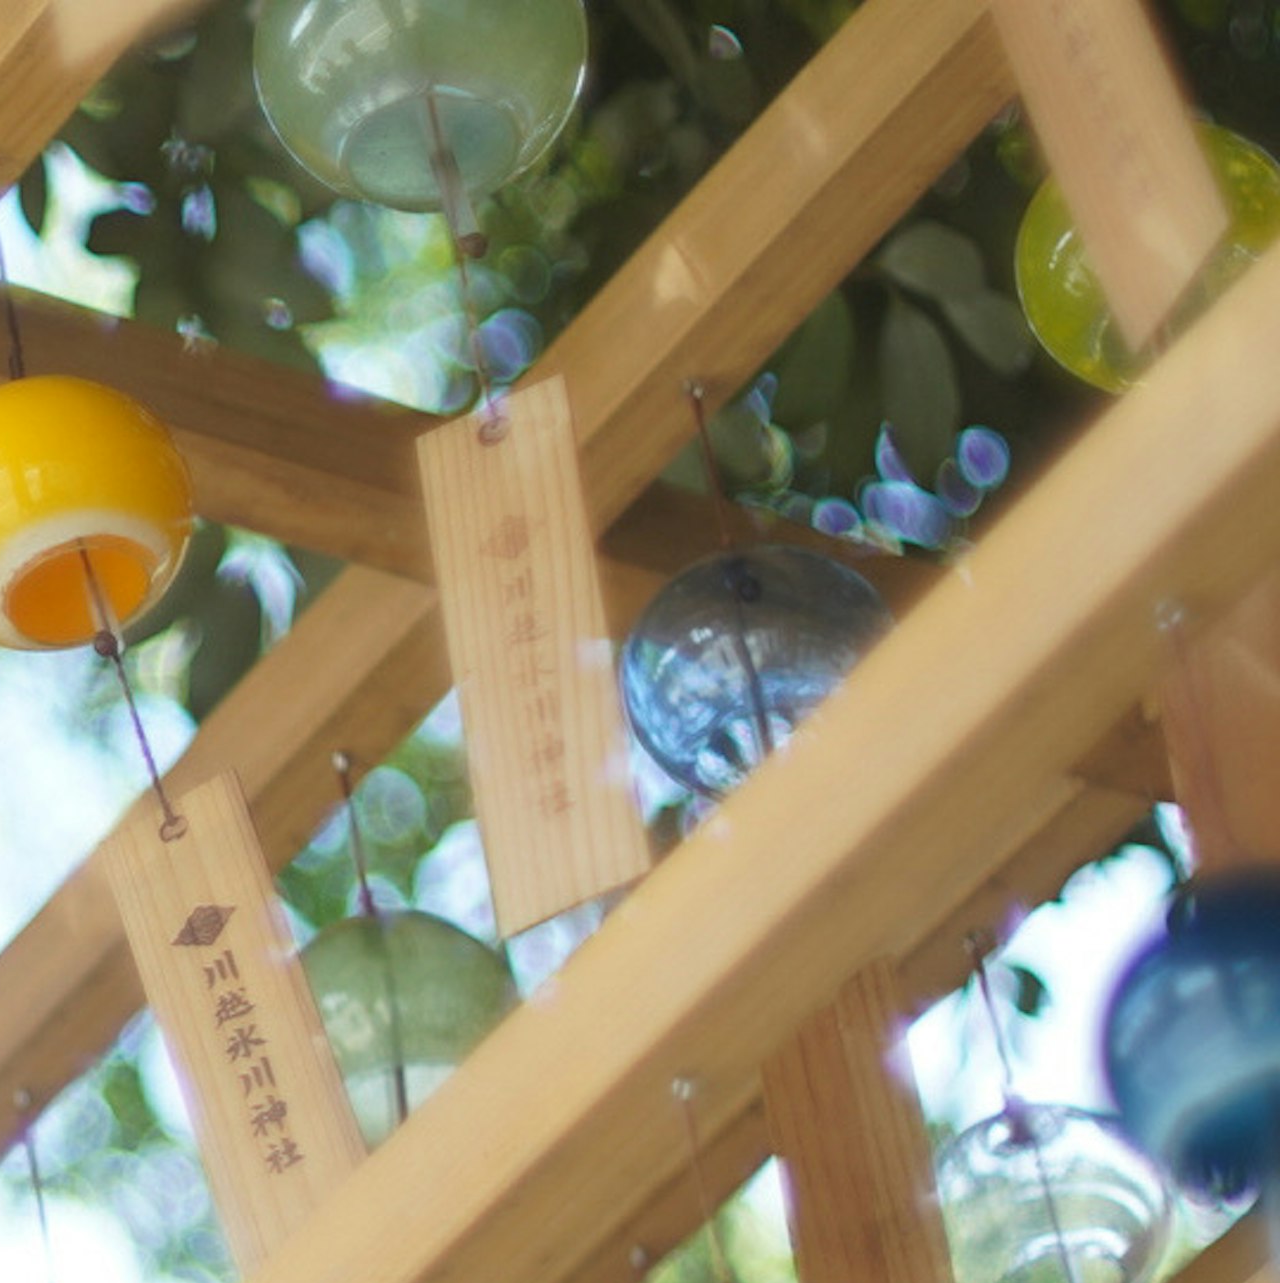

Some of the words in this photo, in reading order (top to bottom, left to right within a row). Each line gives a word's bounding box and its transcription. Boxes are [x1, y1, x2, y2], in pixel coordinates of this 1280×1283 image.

[203, 949, 306, 1175] 川越氷川神社
